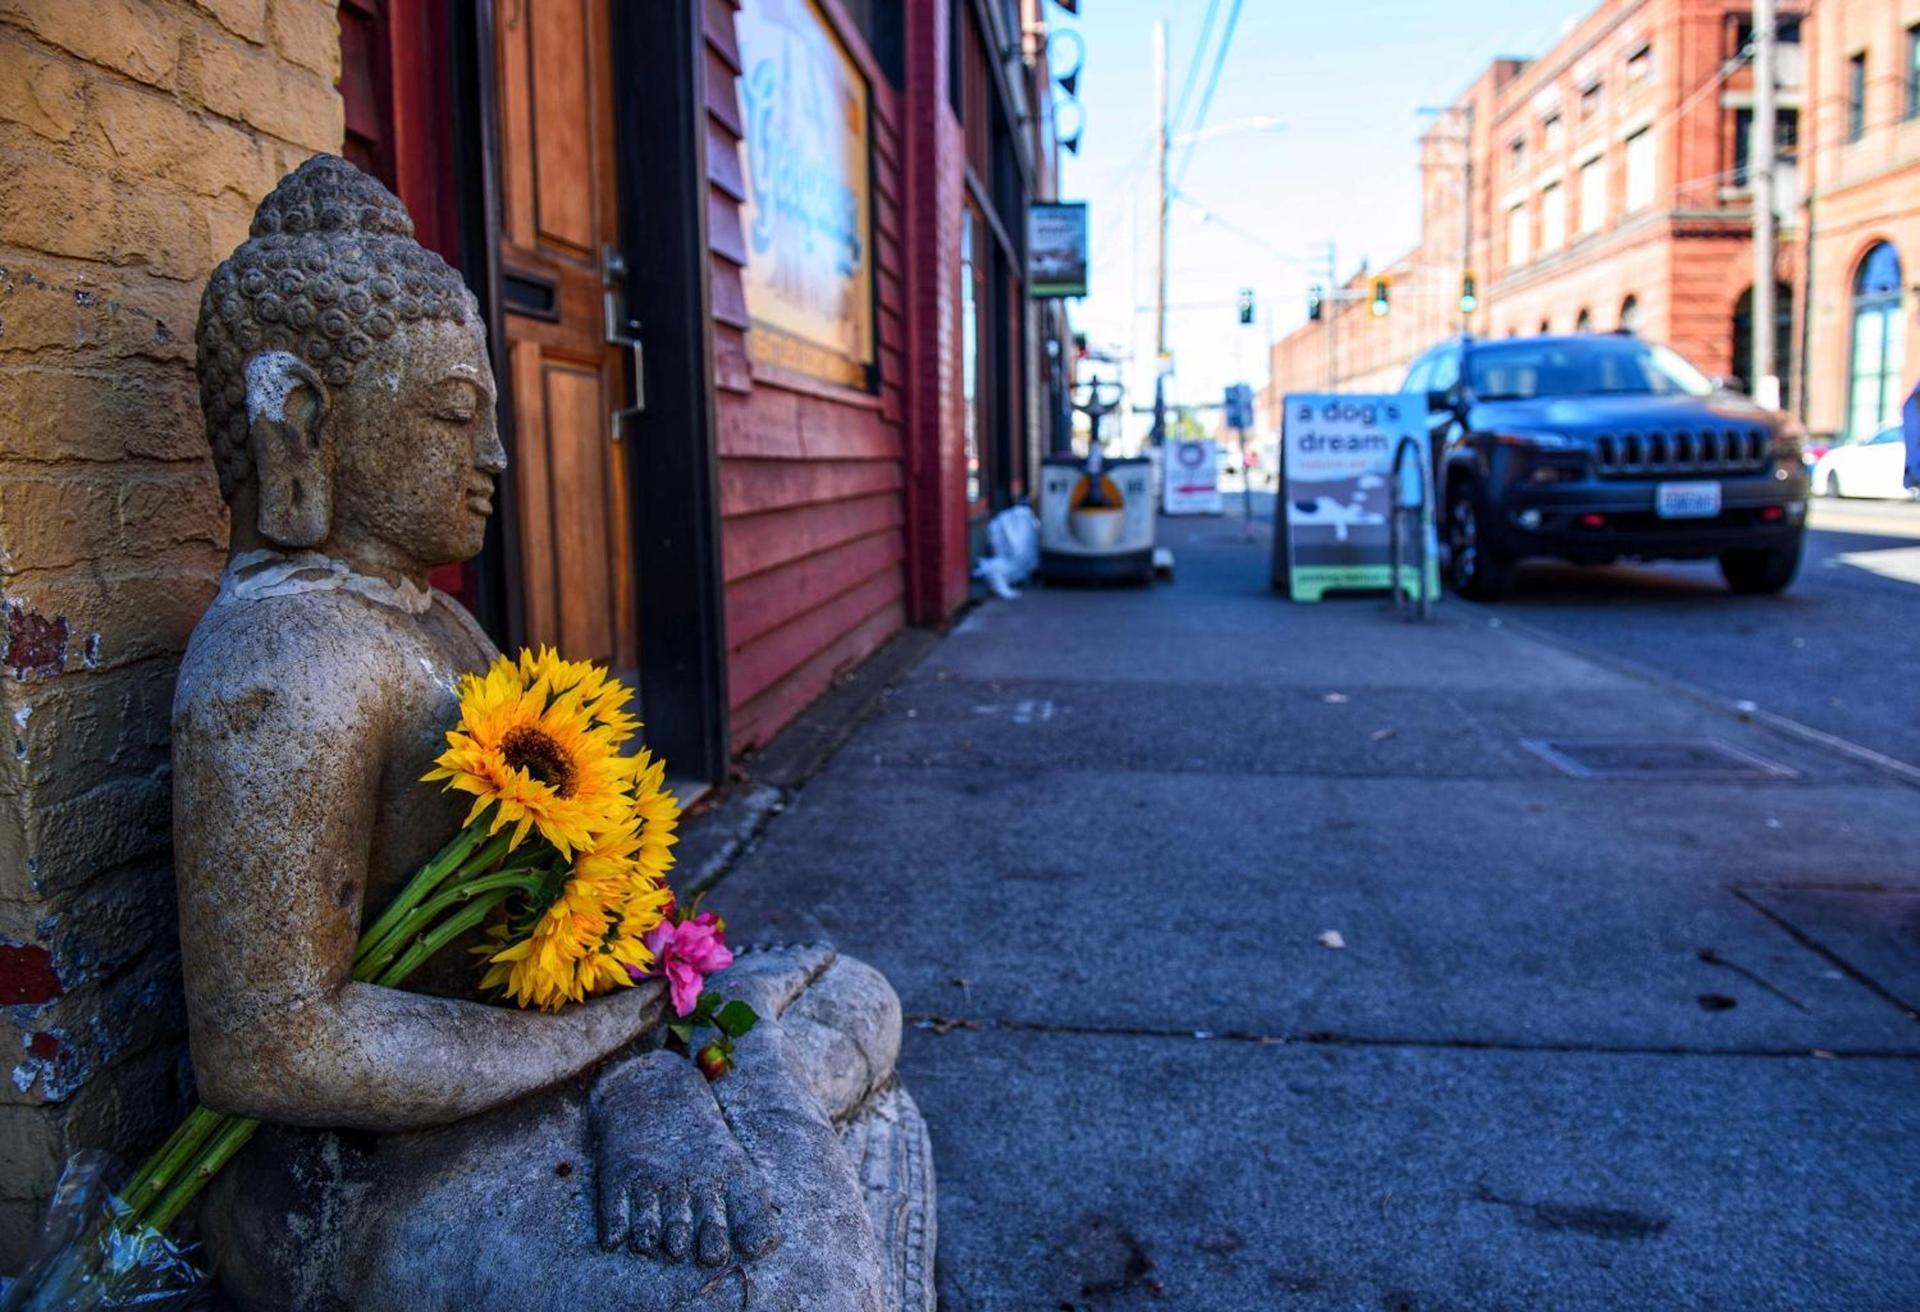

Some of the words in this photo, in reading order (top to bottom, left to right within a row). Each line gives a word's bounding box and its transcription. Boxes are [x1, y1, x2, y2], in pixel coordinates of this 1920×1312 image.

[1298, 406, 1312, 422] a
[1323, 401, 1400, 426] dog's
[1298, 431, 1389, 452] dream
